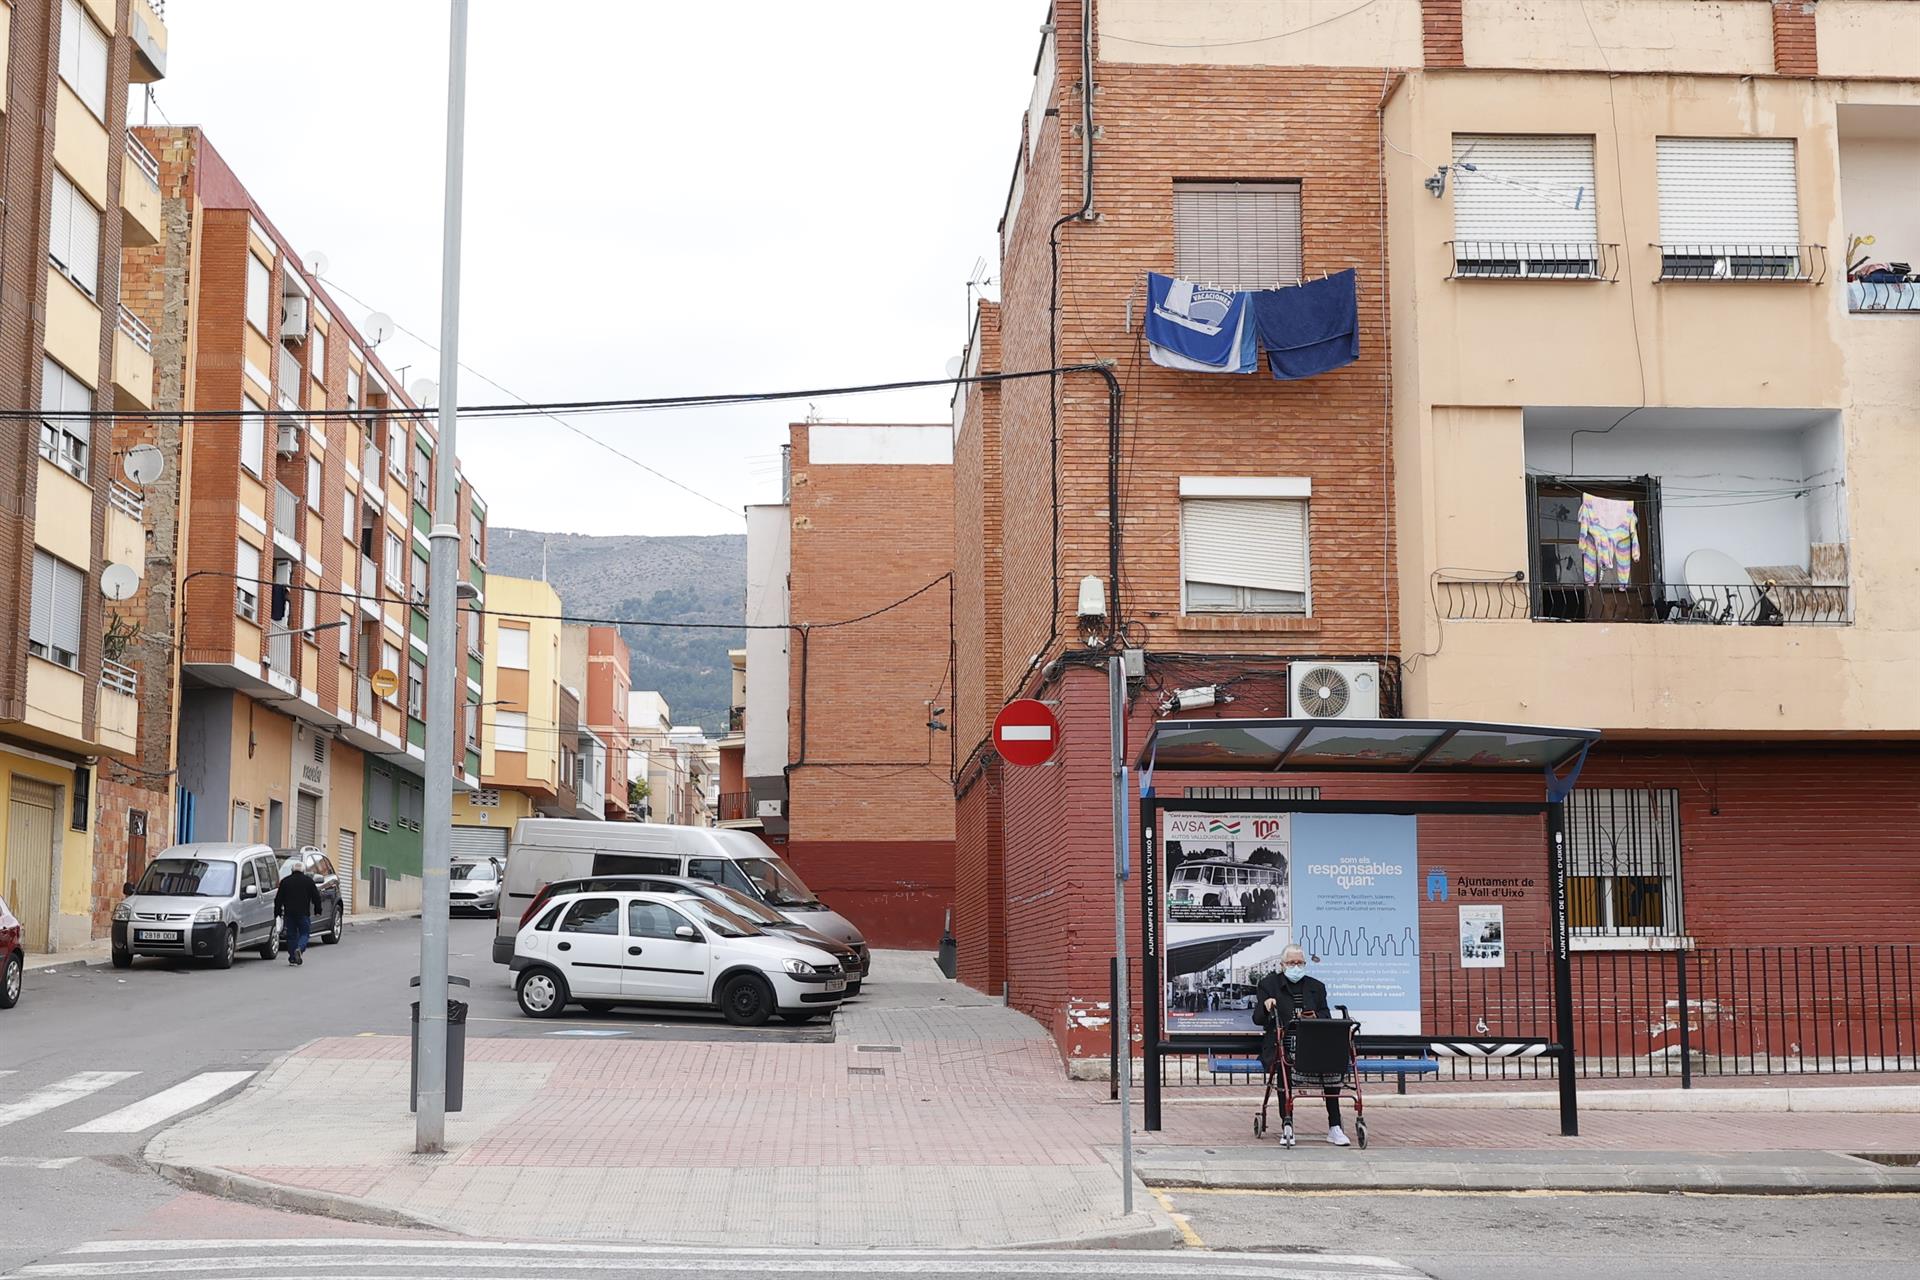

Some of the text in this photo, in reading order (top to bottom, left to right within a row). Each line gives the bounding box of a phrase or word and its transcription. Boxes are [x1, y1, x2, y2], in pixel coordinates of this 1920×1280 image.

[1171, 821, 1206, 832] AVSA
[1308, 862, 1402, 877] responsables
[1337, 876, 1375, 889] quan:
[1457, 876, 1534, 887] Ajuntament de
[1147, 885, 1153, 894] LA
[1457, 888, 1524, 897] la Vall d'Uixó
[1559, 889, 1564, 898] LA
[1148, 896, 1153, 906] DE
[1559, 900, 1564, 909] DE
